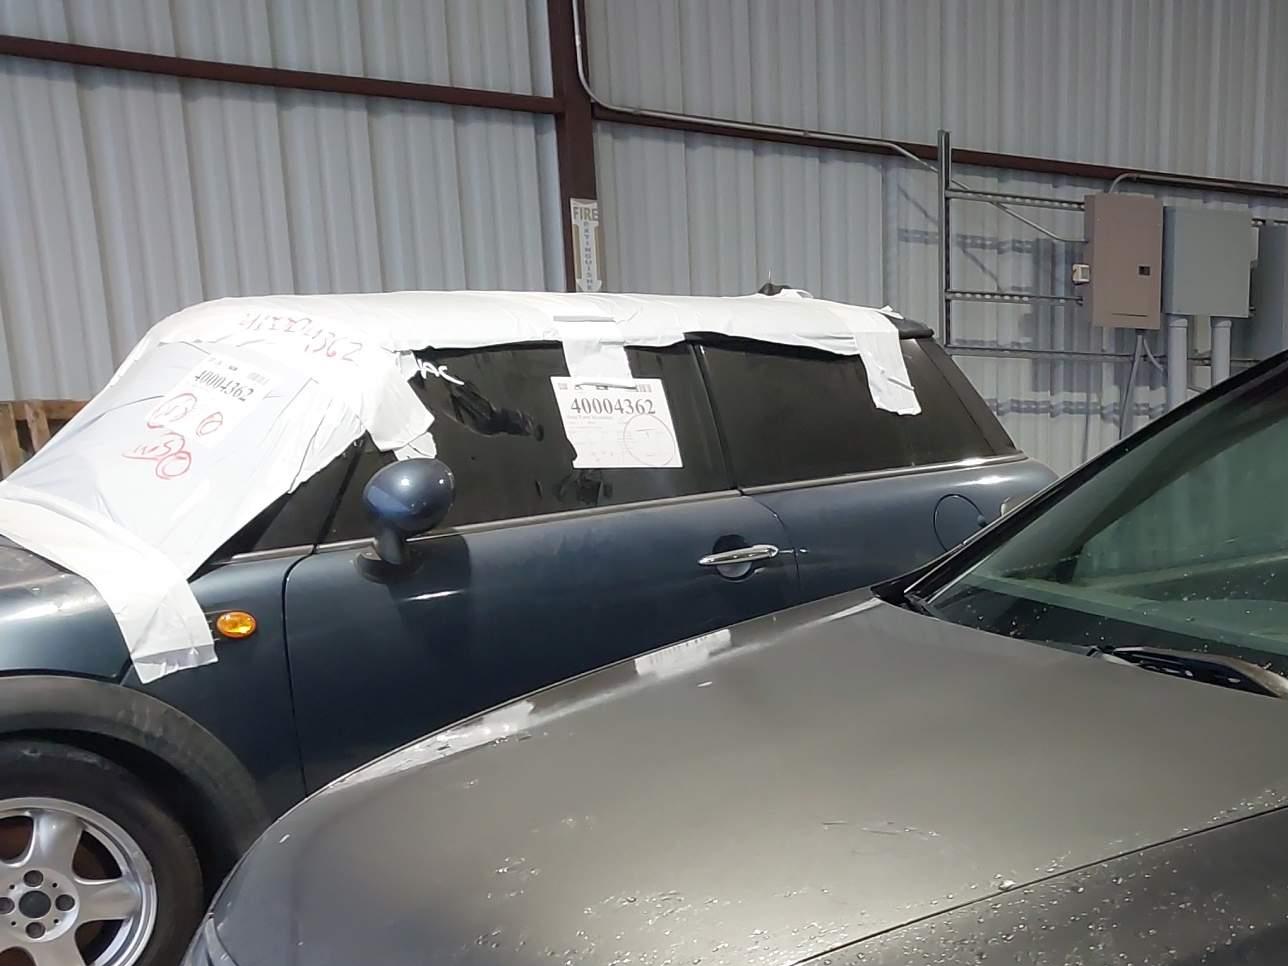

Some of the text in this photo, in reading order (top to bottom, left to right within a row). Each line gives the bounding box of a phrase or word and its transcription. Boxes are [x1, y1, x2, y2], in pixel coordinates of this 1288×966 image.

[573, 207, 600, 221] FIRE
[583, 221, 593, 291] EXTINGUISHE
[195, 369, 254, 402] 40004362
[571, 398, 656, 414] 40004362
